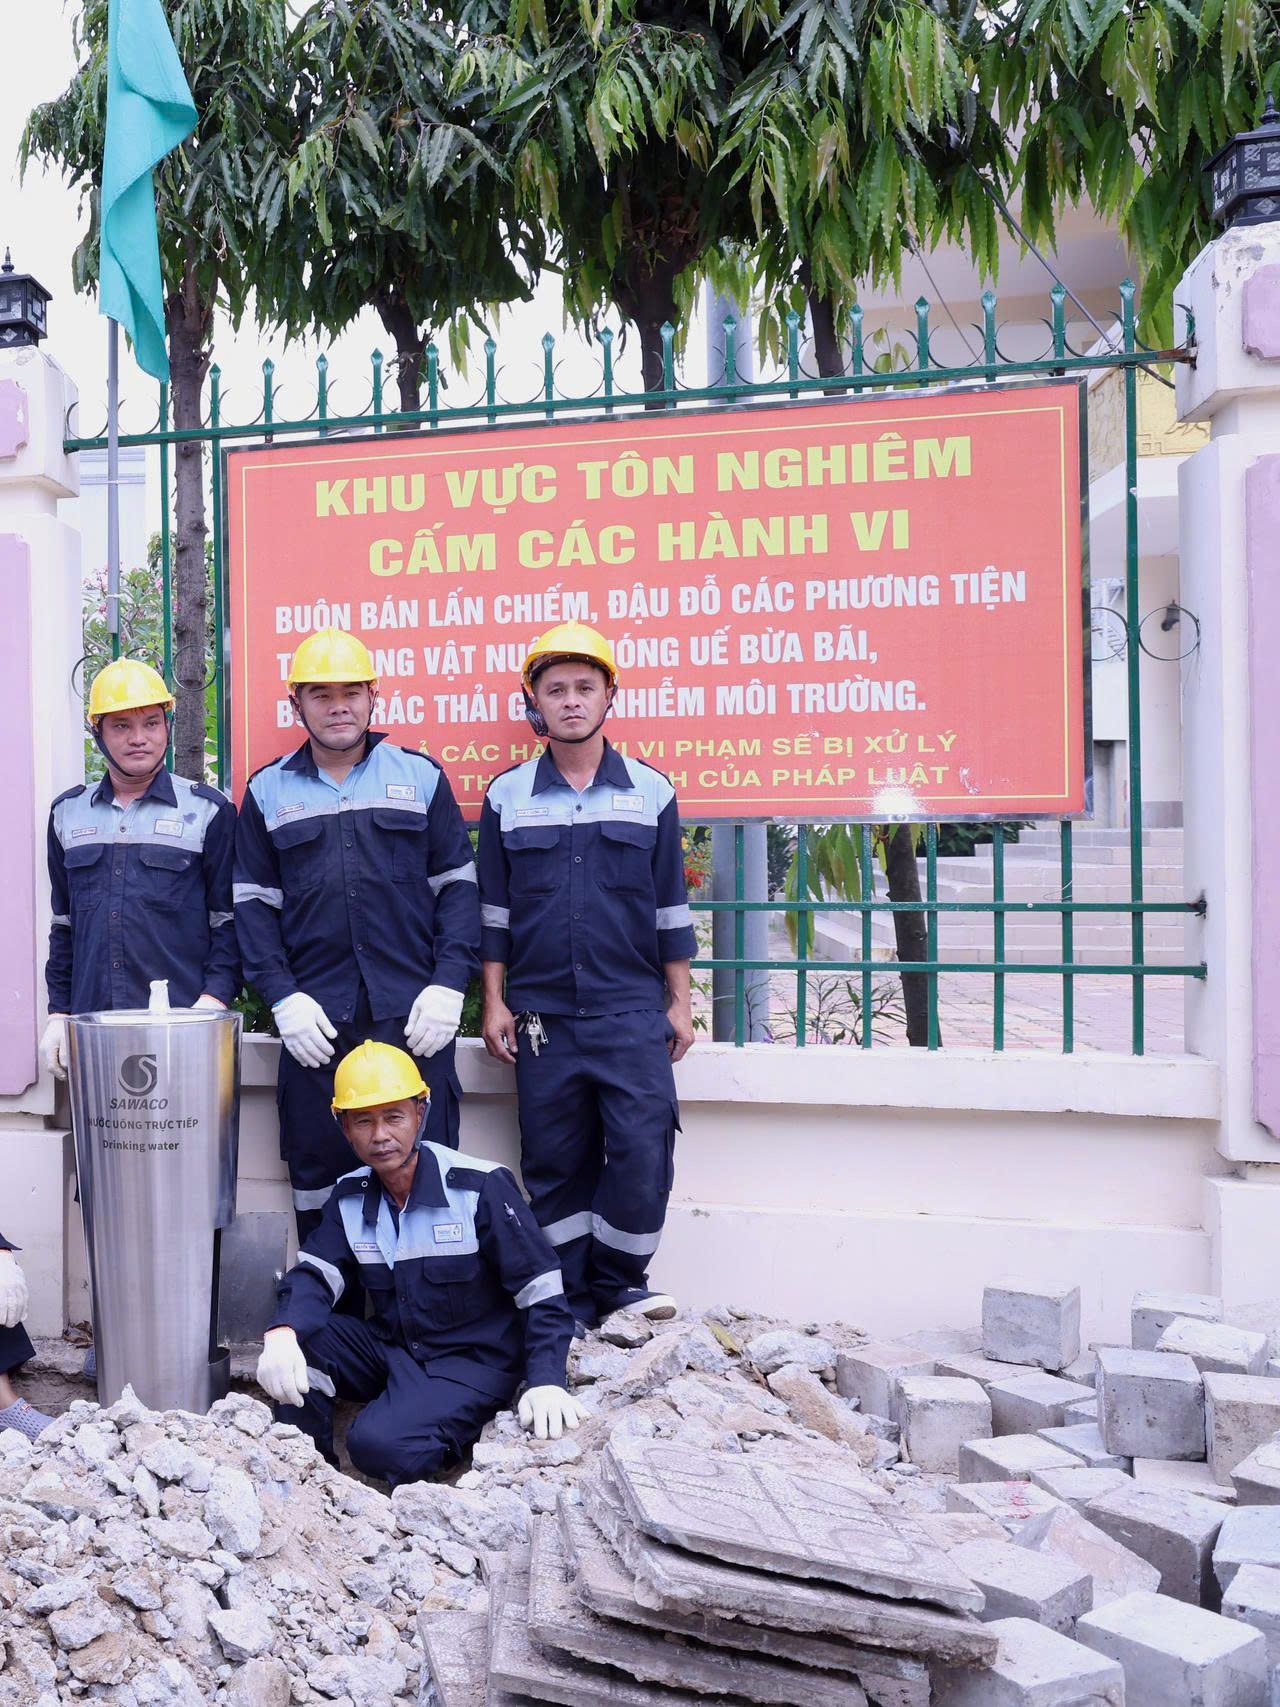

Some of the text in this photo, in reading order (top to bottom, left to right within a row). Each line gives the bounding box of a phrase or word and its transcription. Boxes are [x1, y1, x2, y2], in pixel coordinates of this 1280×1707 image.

[316, 432, 971, 517] KHU VỰC TÔN NGHIÊM
[369, 509, 909, 577] CẤM CÁC HÀNH VI
[276, 565, 1026, 634] BUÔN BÁN LẤN CHIẾM, ĐẬU ĐỖ CÁC PHƯƠNG TIỆN
[424, 640, 476, 681] VẬT
[690, 625, 732, 666] UẾ
[740, 626, 804, 664] BỪA
[814, 624, 878, 664] BÃI,
[370, 690, 425, 725] RÁC
[434, 683, 498, 723] THẢI
[605, 676, 705, 720] NHIỄM
[716, 678, 776, 716] MÔI
[786, 673, 927, 715] TRƯỜNG.
[441, 740, 500, 763] CÁC
[637, 740, 665, 758] VI
[675, 738, 761, 760] PHẠM
[772, 733, 812, 756] SẼ
[823, 736, 853, 758] BỊ
[864, 728, 909, 754] XỬ
[917, 729, 958, 753] LÝ
[698, 763, 762, 788] CỦA
[772, 763, 856, 786] PHÁP
[868, 762, 950, 788] LUẬT
[109, 1098, 168, 1110] SAWACO
[145, 1117, 174, 1132] TRỰC
[176, 1116, 199, 1129] TIẾP
[103, 1139, 180, 1153] Drinking water
